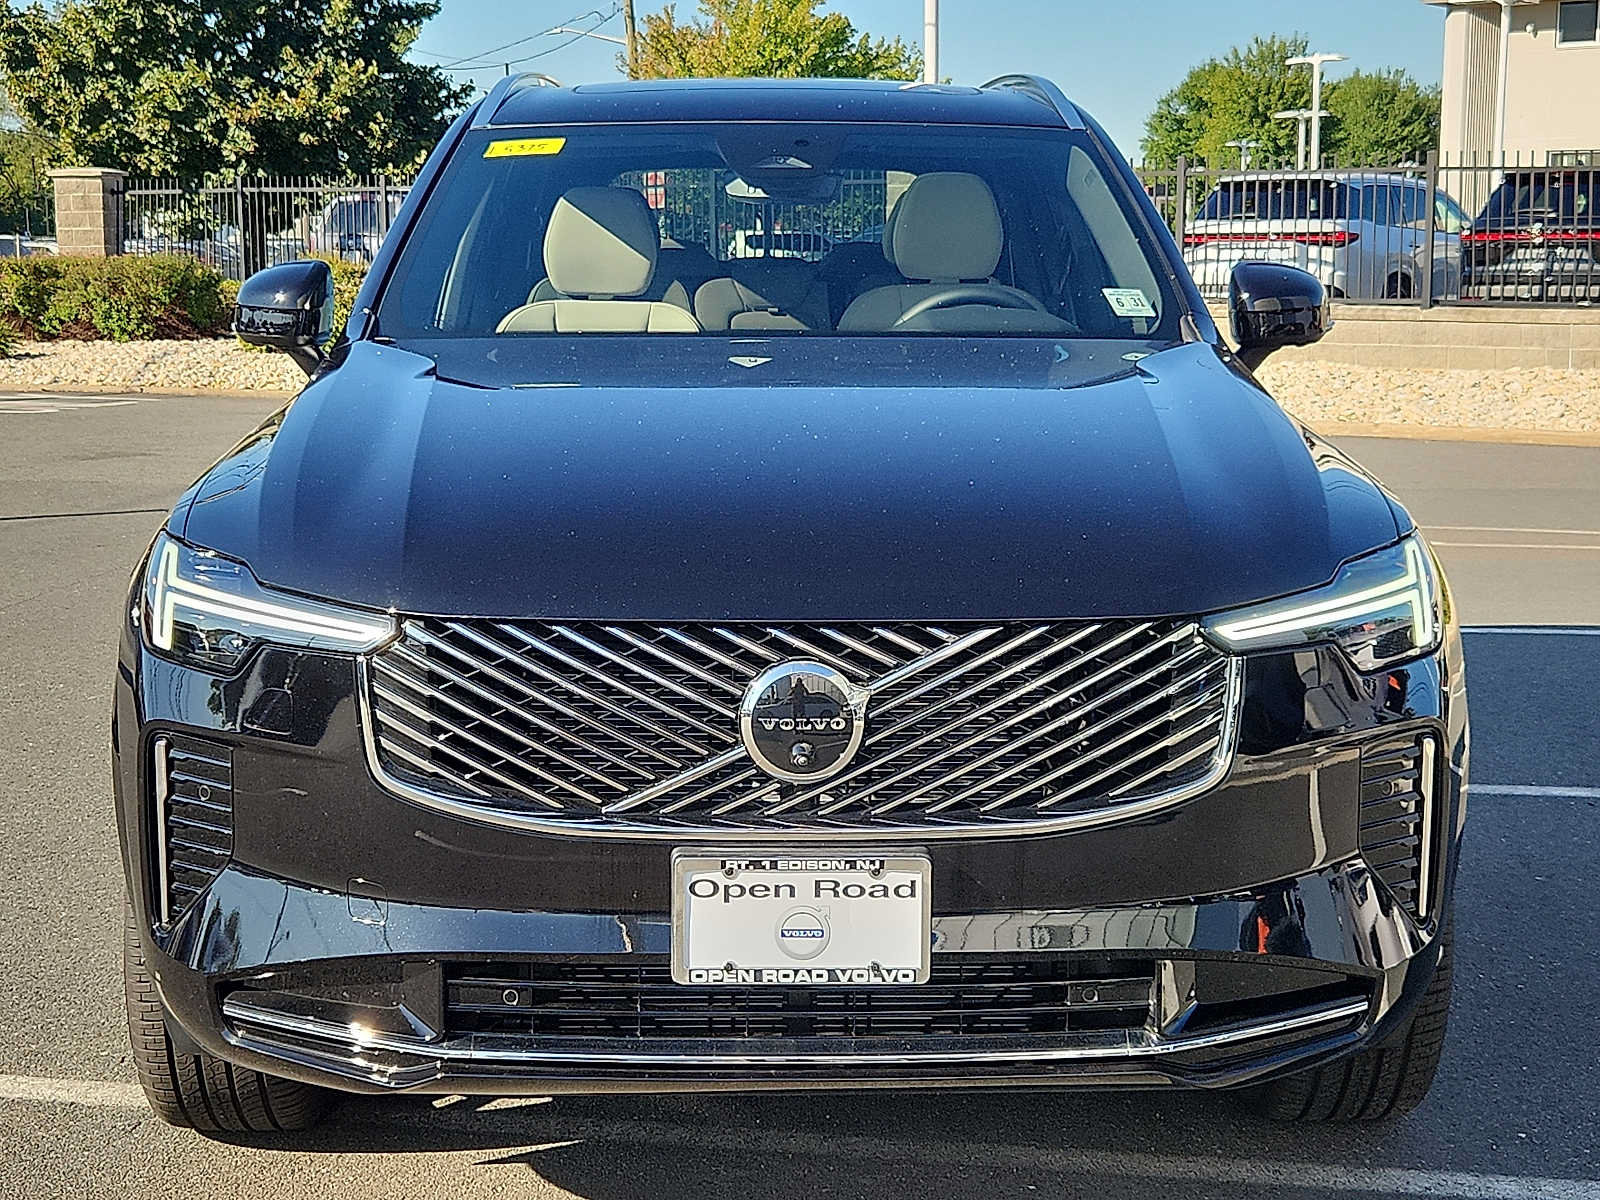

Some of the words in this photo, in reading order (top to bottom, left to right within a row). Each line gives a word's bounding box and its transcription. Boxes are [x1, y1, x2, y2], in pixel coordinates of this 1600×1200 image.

[1116, 297, 1125, 307] 6
[758, 717, 846, 730] VOLVO
[725, 860, 754, 870] RT.
[761, 860, 771, 870] 1
[777, 860, 850, 870] EDISON,
[856, 860, 881, 870] NJ
[688, 879, 796, 903] Open
[814, 879, 917, 899] Road
[690, 969, 755, 983] OPEN
[762, 969, 829, 983] ROAD
[834, 969, 915, 983] VOLVO
